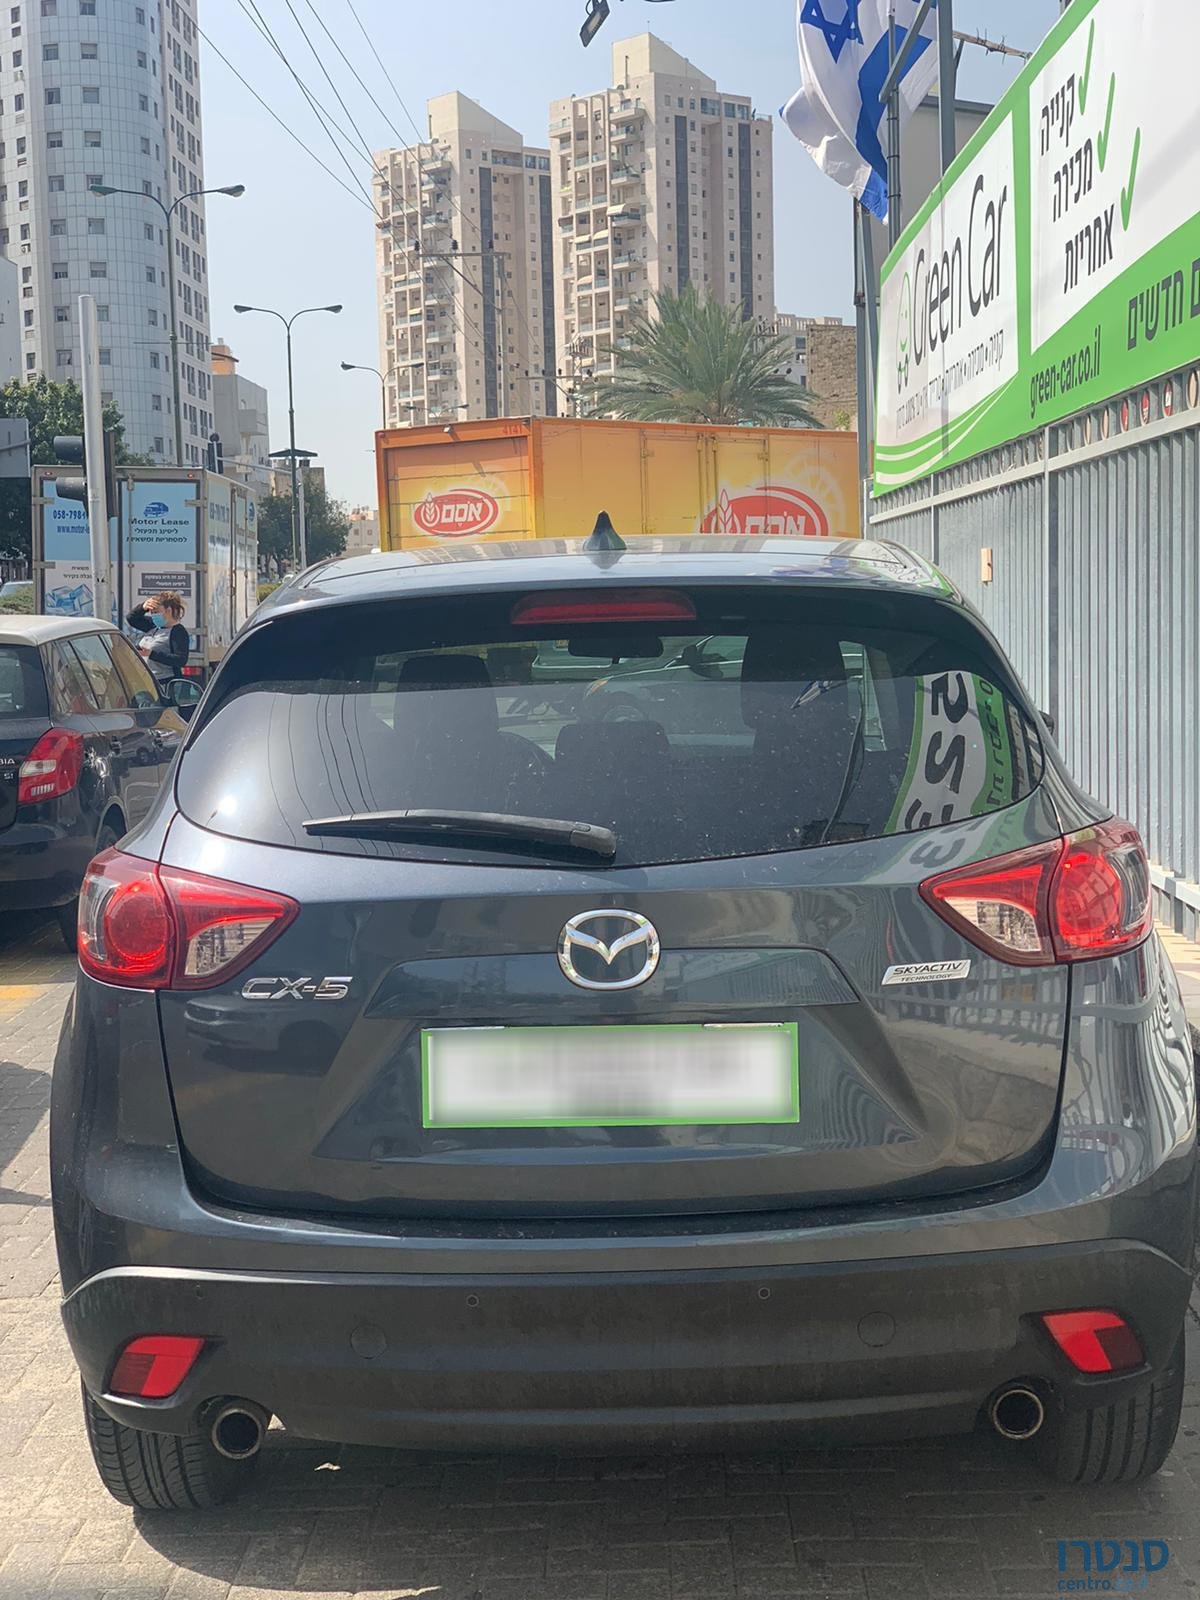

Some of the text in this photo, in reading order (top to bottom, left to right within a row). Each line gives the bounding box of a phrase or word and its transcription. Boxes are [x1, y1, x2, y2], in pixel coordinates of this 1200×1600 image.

[1040, 73, 1075, 156] קנייה
[1053, 138, 1092, 223] מכירה
[913, 174, 1007, 366] Green Car
[1064, 203, 1114, 294] אחריות
[1127, 269, 1184, 351] חדשים
[1030, 324, 1101, 419] green-car.co.il
[441, 501, 482, 524] אסם
[241, 976, 353, 1000] CX-5
[893, 962, 962, 975] SKYACTIV
[901, 973, 952, 982] TECHNOLOGY
